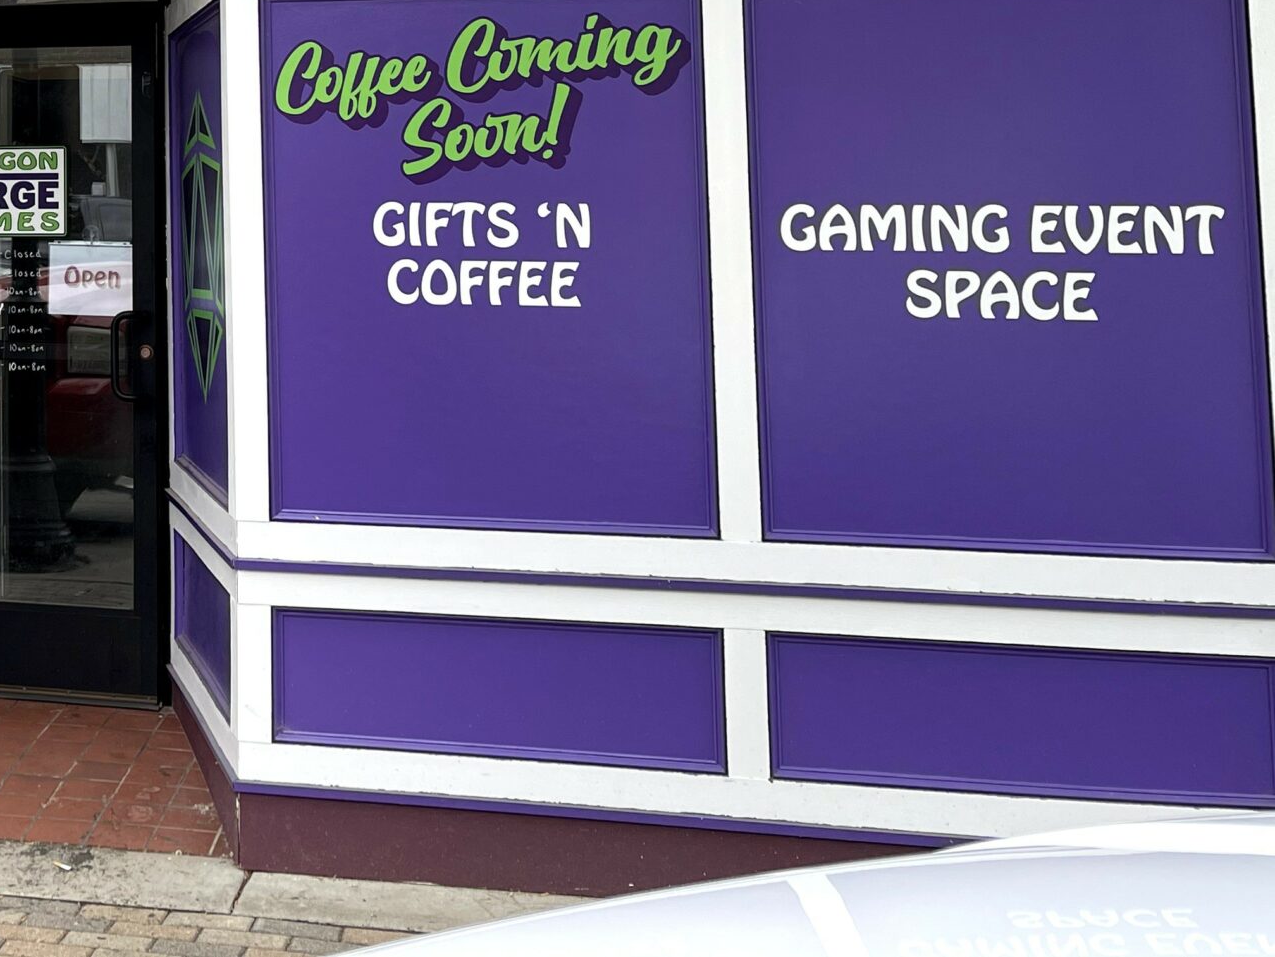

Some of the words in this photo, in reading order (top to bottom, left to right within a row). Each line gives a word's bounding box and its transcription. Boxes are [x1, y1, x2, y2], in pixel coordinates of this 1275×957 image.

[274, 39, 432, 122] Coffee
[445, 13, 682, 95] Coming
[401, 82, 572, 177] Soon!
[372, 200, 520, 248] GIFTS
[780, 203, 1011, 253] GAMING
[1030, 204, 1226, 255] EVENT
[4, 249, 42, 259] Closed
[63, 265, 121, 290] Open
[386, 258, 582, 308] COFFEE
[905, 268, 1099, 322] SPACE
